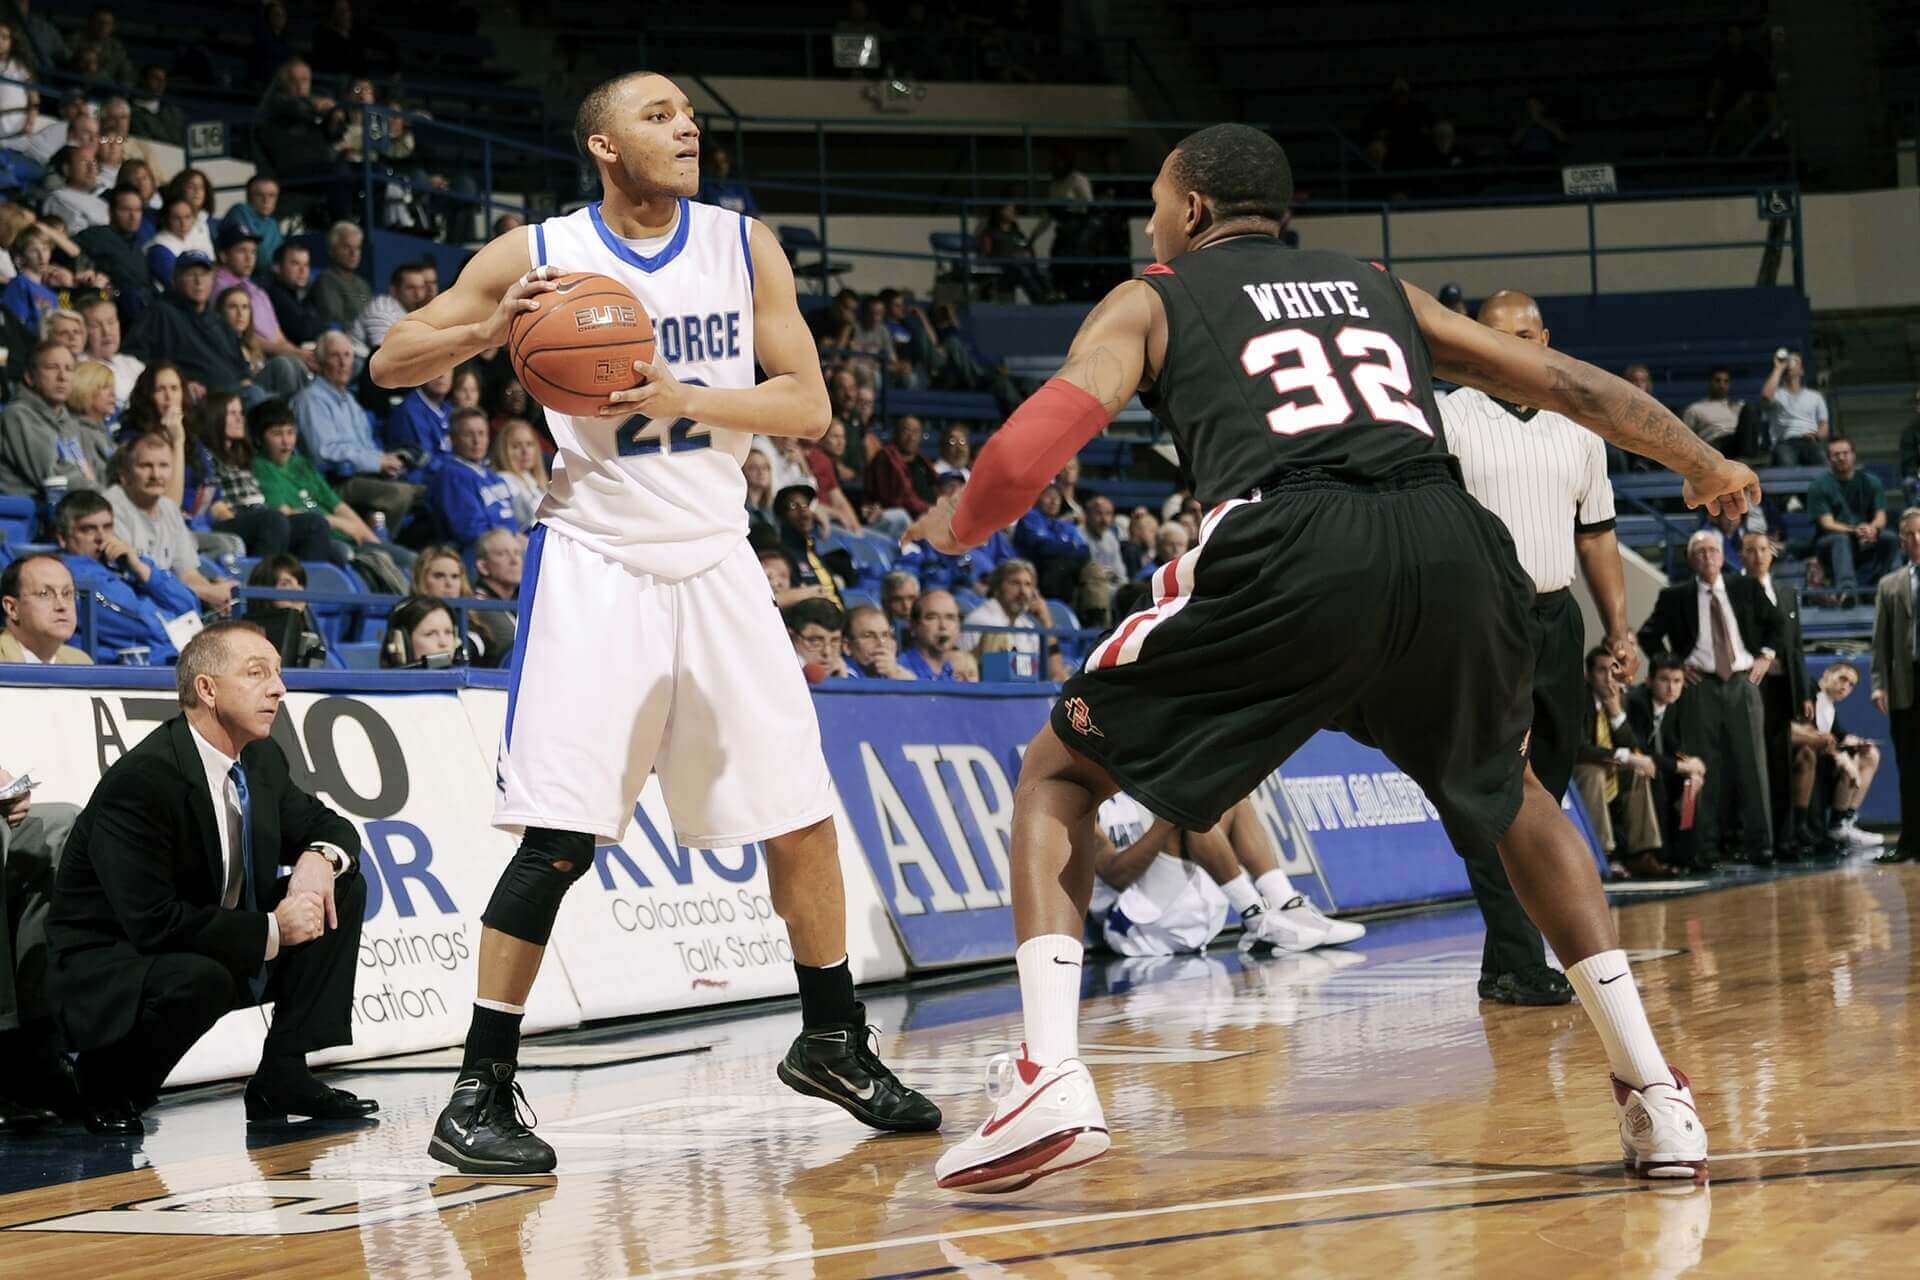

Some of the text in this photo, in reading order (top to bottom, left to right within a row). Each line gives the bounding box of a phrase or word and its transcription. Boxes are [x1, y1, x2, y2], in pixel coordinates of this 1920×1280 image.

[1242, 281, 1370, 322] WHITE
[652, 310, 741, 364] ORCE
[1239, 326, 1435, 437] 32
[615, 377, 712, 457] 22
[859, 741, 1014, 915] AIR
[612, 892, 736, 932] Colorado
[674, 933, 795, 974] Talk Statio
[352, 983, 448, 1025] ation
